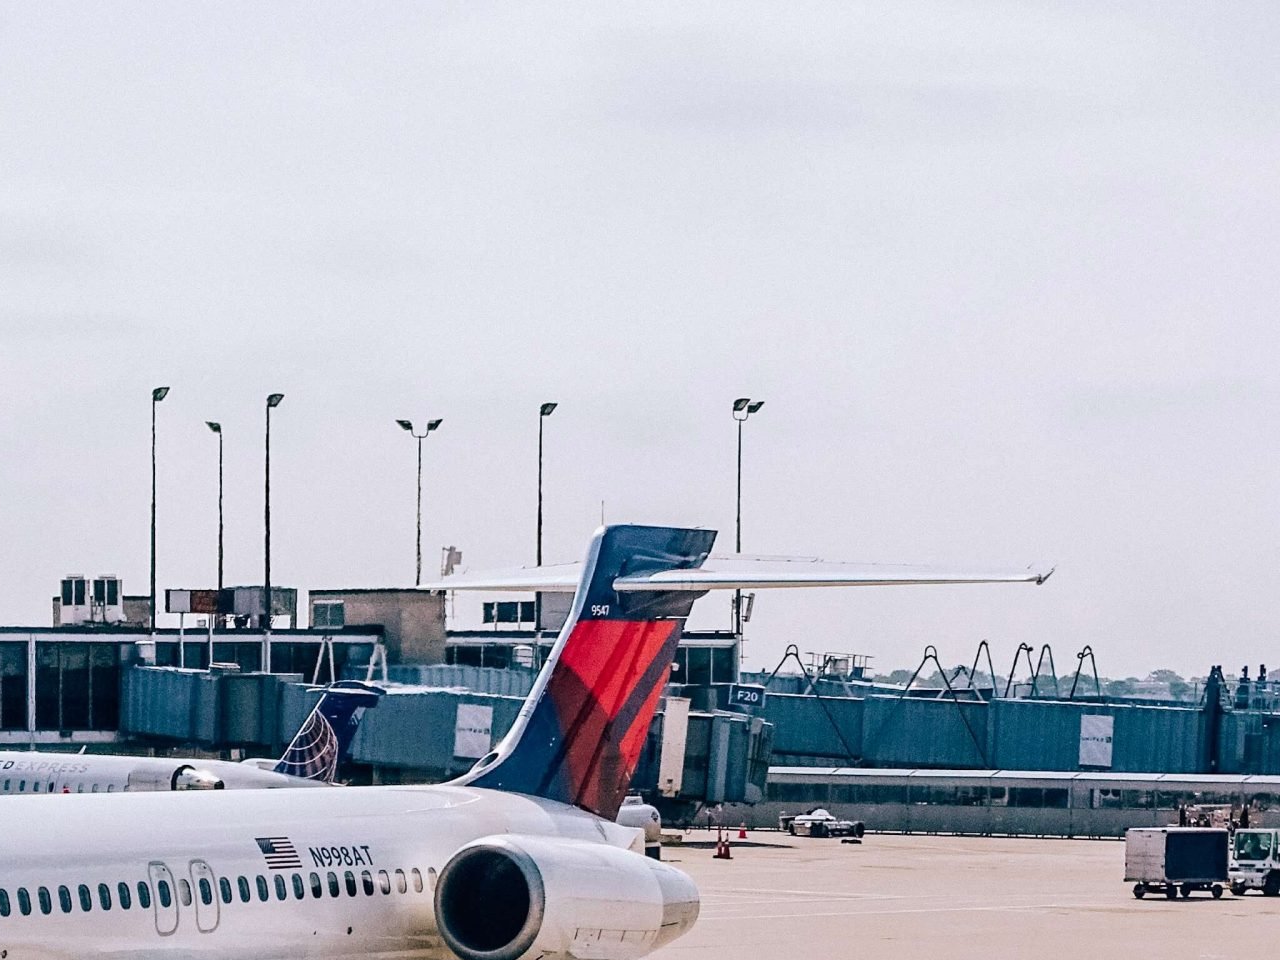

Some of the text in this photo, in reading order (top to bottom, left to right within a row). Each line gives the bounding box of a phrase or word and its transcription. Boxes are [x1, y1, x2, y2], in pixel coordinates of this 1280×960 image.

[591, 604, 610, 616] 9547
[737, 690, 759, 702] F20
[15, 760, 90, 773] EXPRESS
[308, 845, 373, 867] N998AT
